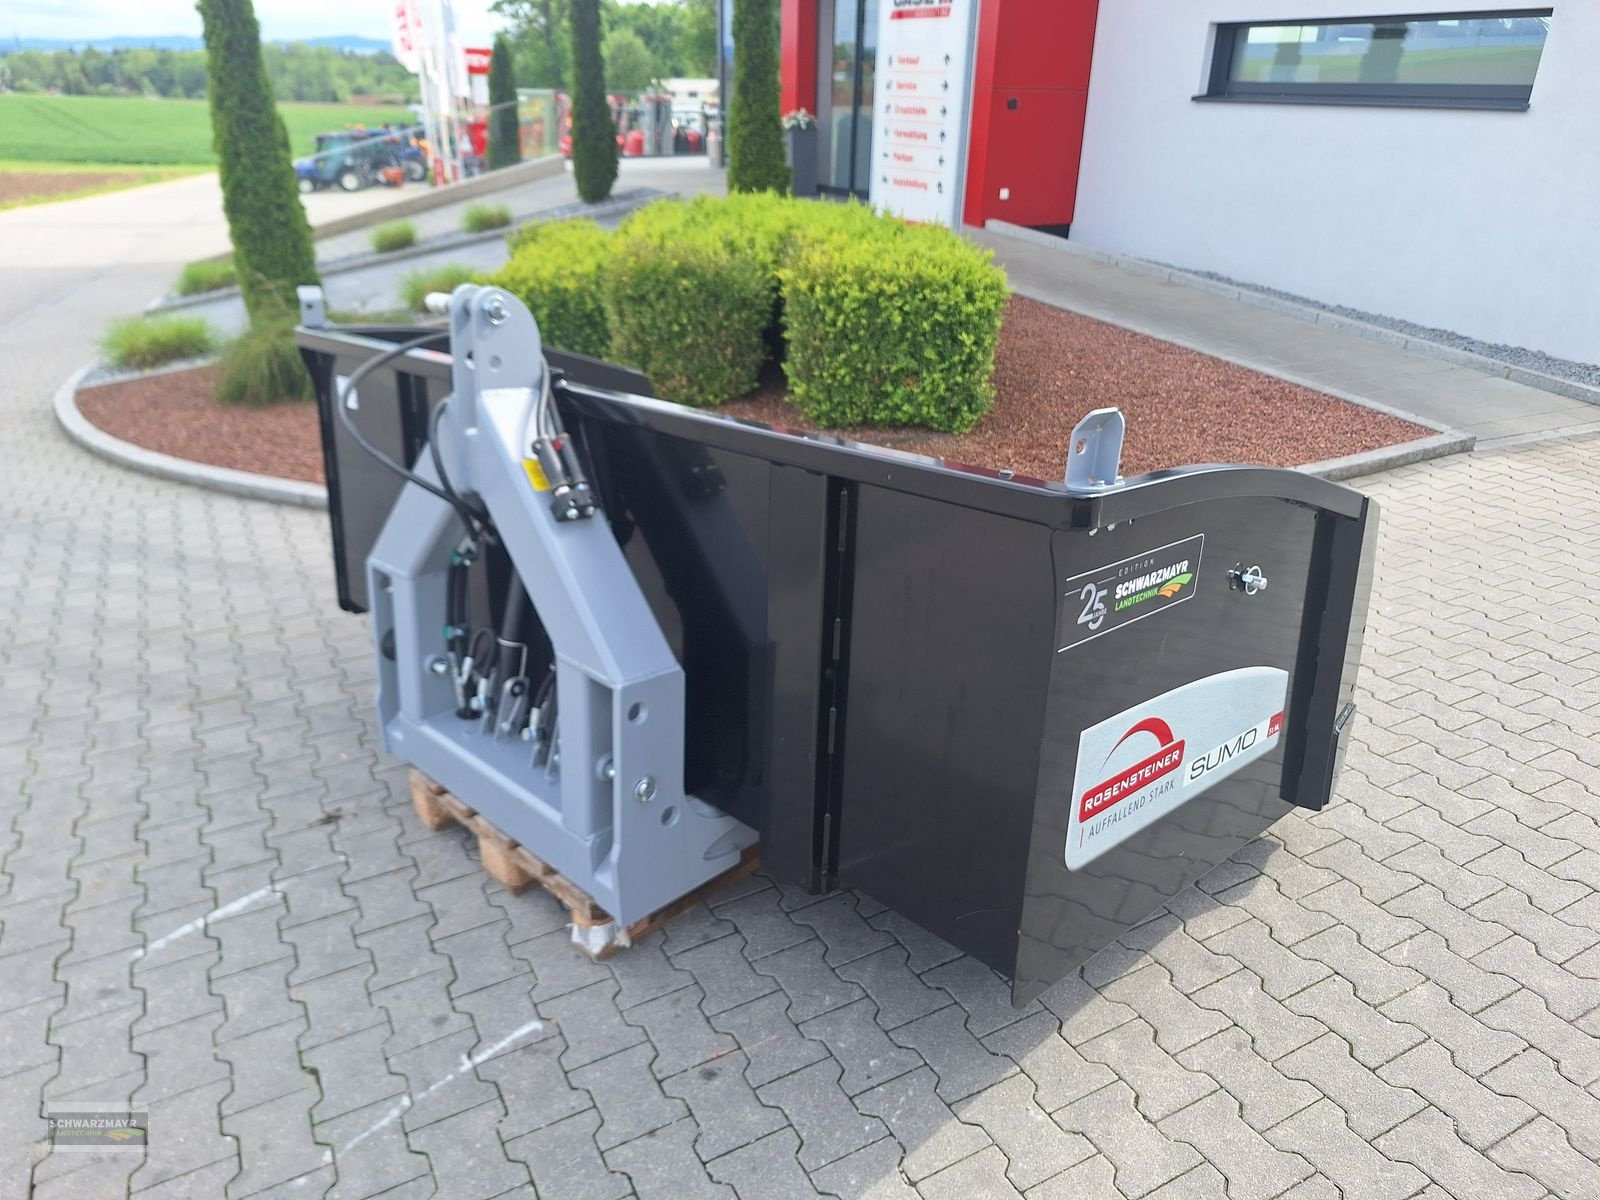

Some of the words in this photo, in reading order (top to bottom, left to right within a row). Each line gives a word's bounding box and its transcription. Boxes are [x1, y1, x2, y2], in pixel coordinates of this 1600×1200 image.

[1114, 560, 1189, 599] SCHWARZMAYR
[1118, 558, 1154, 577] EDITION
[1077, 583, 1107, 630] 25
[1114, 586, 1159, 612] LANDTECHNIK
[1190, 727, 1257, 780] SUMO
[1084, 749, 1180, 812] ROSENSTEINER
[1088, 796, 1146, 840] AUFFALLEND
[1148, 779, 1175, 803] STARK
